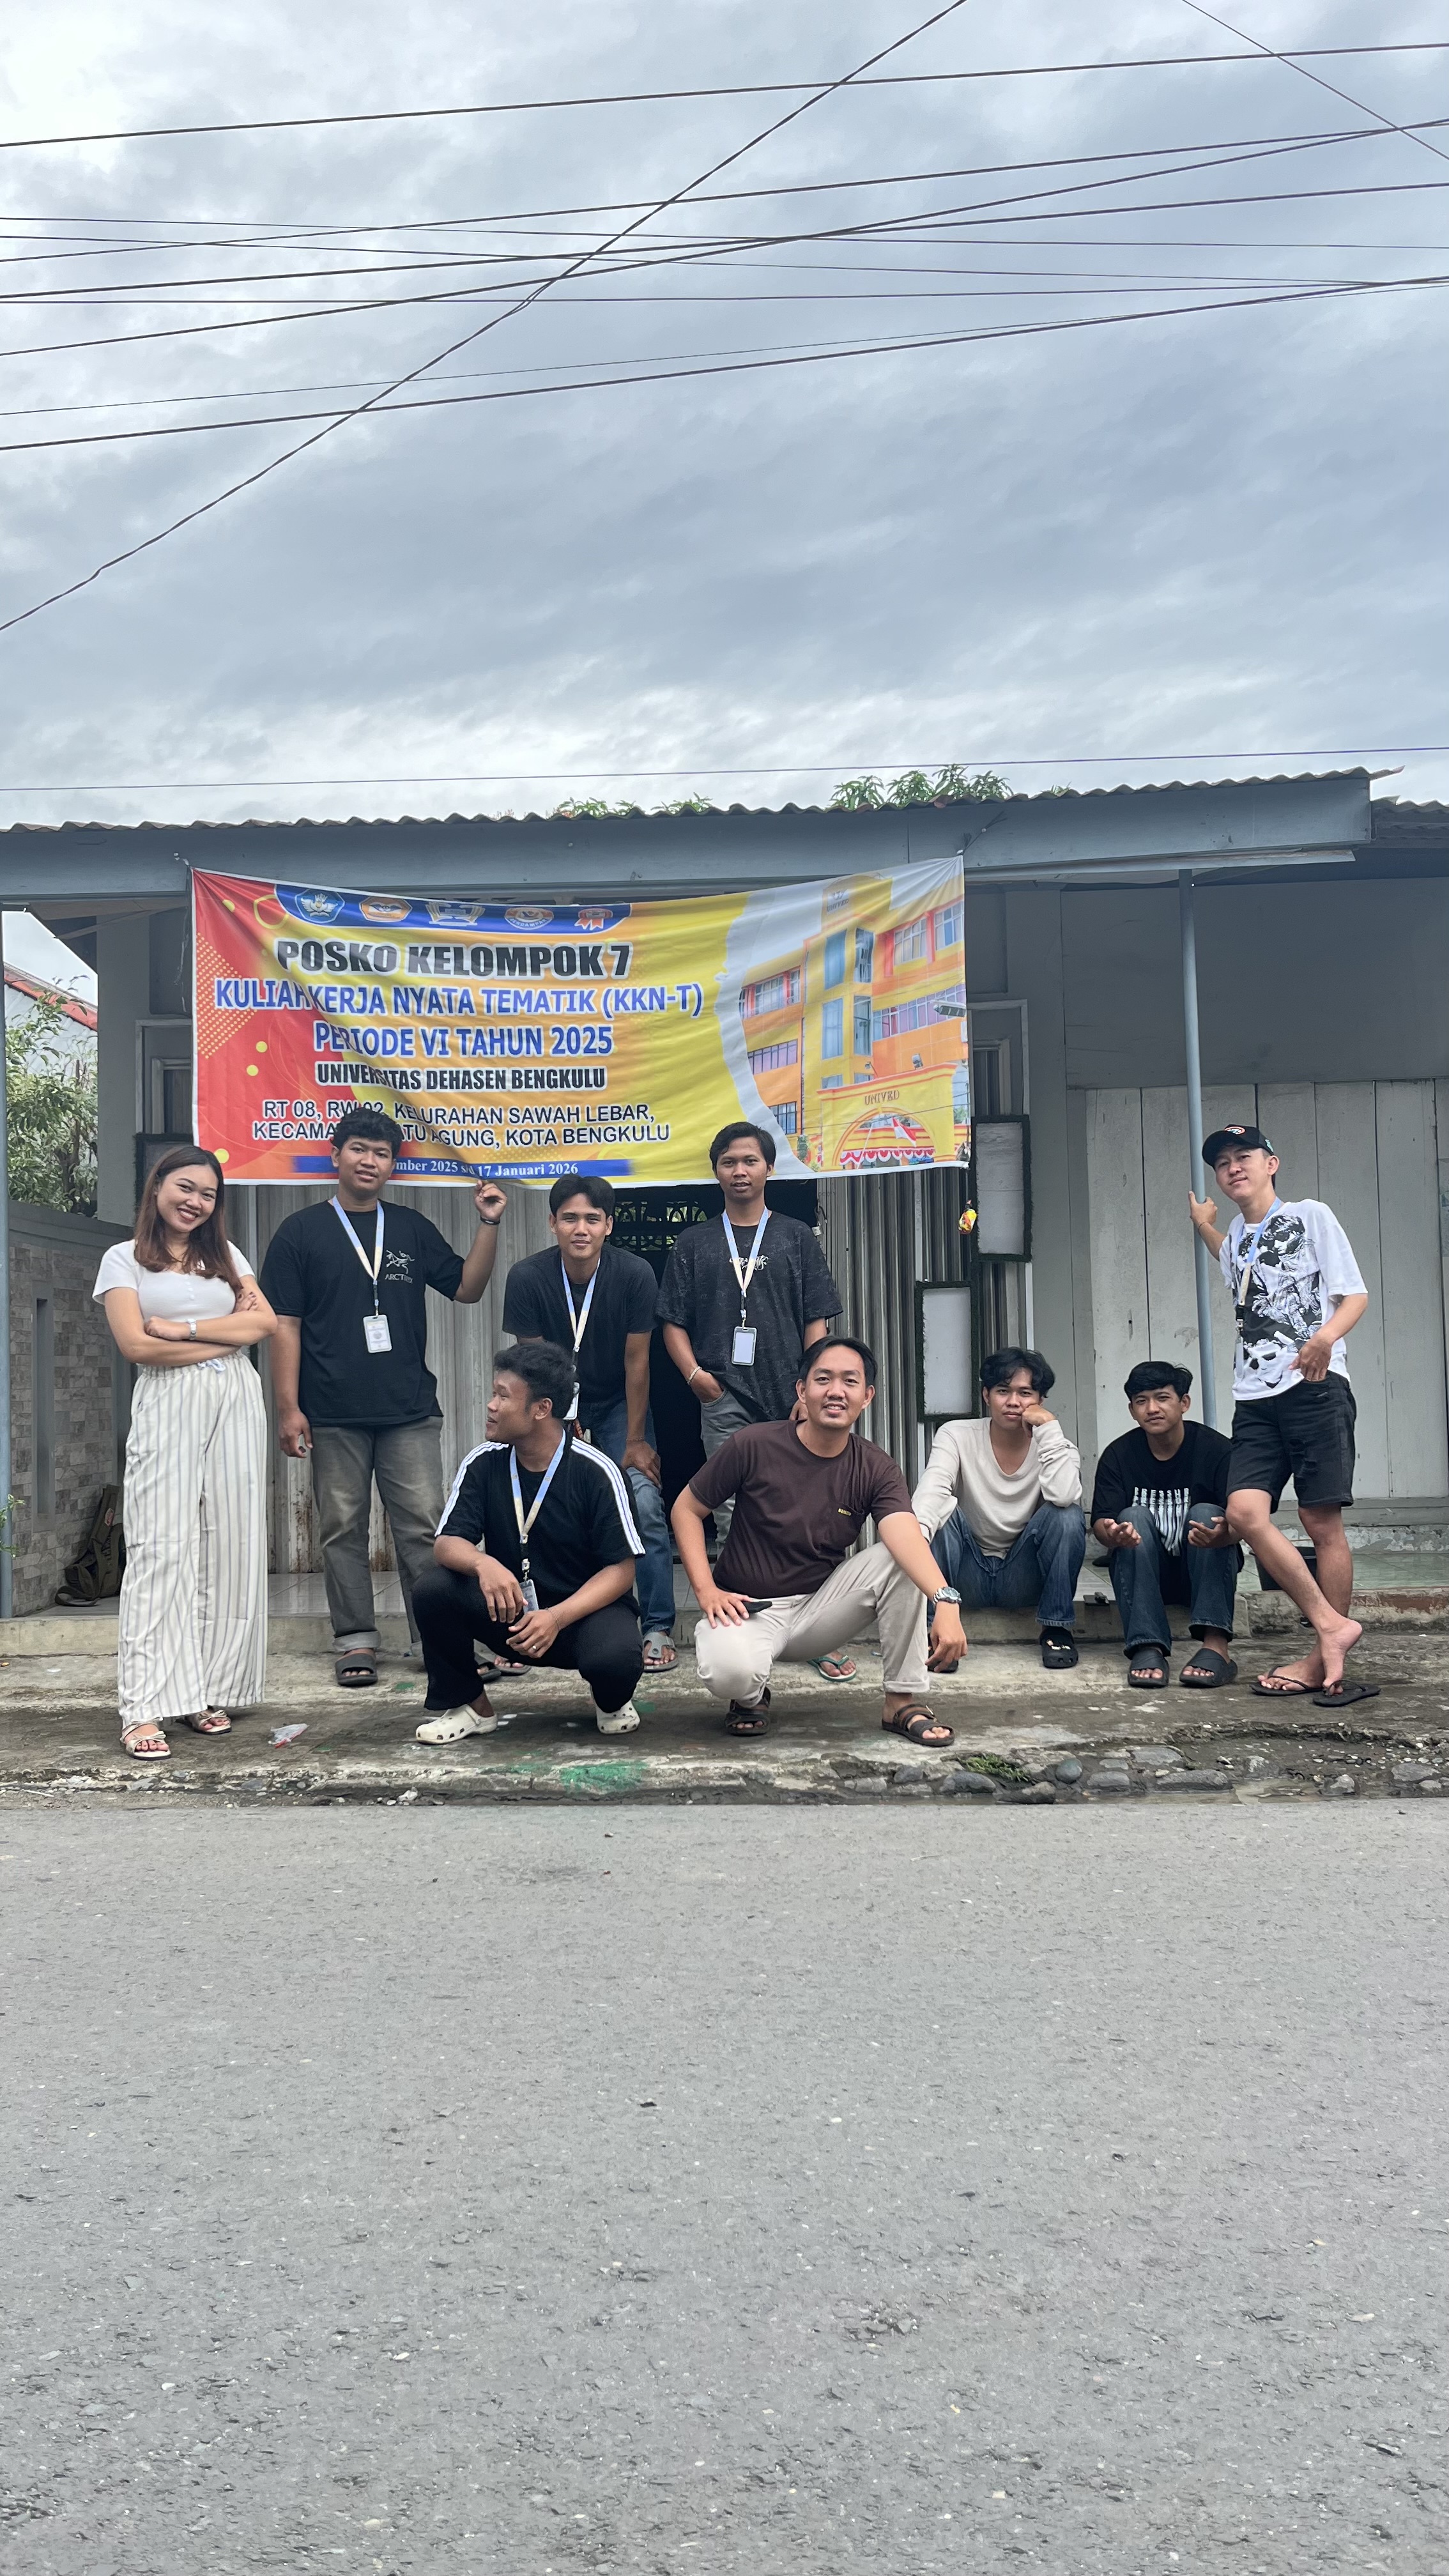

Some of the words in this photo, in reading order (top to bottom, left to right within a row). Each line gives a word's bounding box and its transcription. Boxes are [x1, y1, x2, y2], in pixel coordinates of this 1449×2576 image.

[277, 940, 397, 972] POSKO
[408, 945, 604, 977] KELOMPOK
[611, 945, 630, 976] 7
[216, 979, 312, 1008] KULIAH
[308, 985, 386, 1014] KERJA
[394, 987, 475, 1014] NYATA
[481, 989, 596, 1014] TEMATIK
[602, 983, 703, 1018] (KKN-T)
[315, 1022, 414, 1056] PERIODE
[421, 1029, 449, 1055] VI
[456, 1027, 542, 1055] TAHUN
[551, 1026, 612, 1054] 2025
[317, 1063, 422, 1090] UNIVERSITAS
[426, 1070, 507, 1090] DEHASEN
[511, 1068, 605, 1089] BENGKULU
[864, 1089, 900, 1105] UNIVED
[264, 1101, 288, 1117] RT
[293, 1101, 321, 1121] 08,
[328, 1101, 358, 1117] RW
[394, 1102, 503, 1124] KELURAHAN
[509, 1107, 580, 1124] SAWAH
[586, 1104, 654, 1123] LEBAR,
[254, 1123, 338, 1139] KECAMA
[402, 1124, 426, 1141] TU
[431, 1129, 500, 1149] AGUNG,
[506, 1128, 557, 1146] KOTA
[563, 1124, 670, 1144] BENGKULU
[396, 1160, 427, 1172] mber
[430, 1160, 458, 1172] 2025
[478, 1165, 492, 1177] 17
[494, 1163, 545, 1177] Januari
[548, 1162, 579, 1175] 2026
